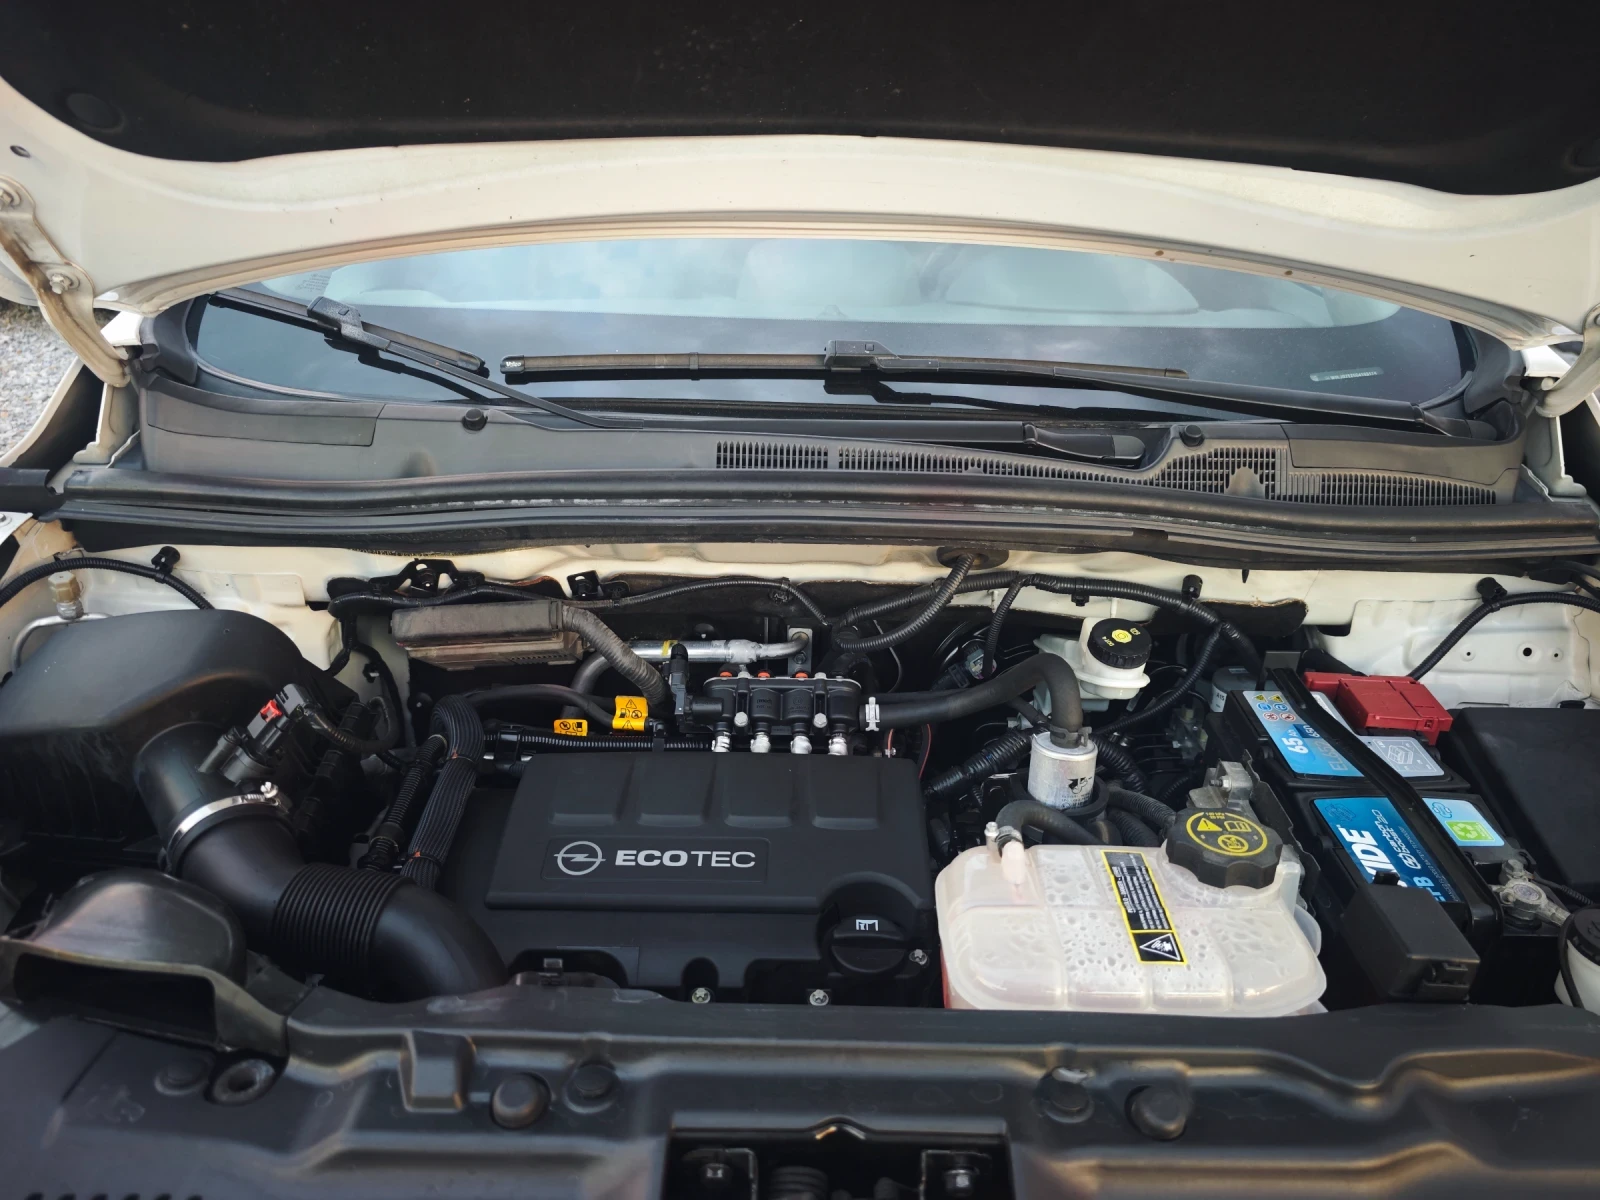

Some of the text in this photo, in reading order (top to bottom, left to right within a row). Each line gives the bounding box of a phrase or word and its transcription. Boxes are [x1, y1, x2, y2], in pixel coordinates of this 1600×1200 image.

[1281, 737, 1309, 754] 65
[1374, 820, 1402, 853] carbon
[1385, 825, 1410, 854] boost
[615, 849, 756, 868] ECOTEC
[1337, 827, 1408, 888] IDE
